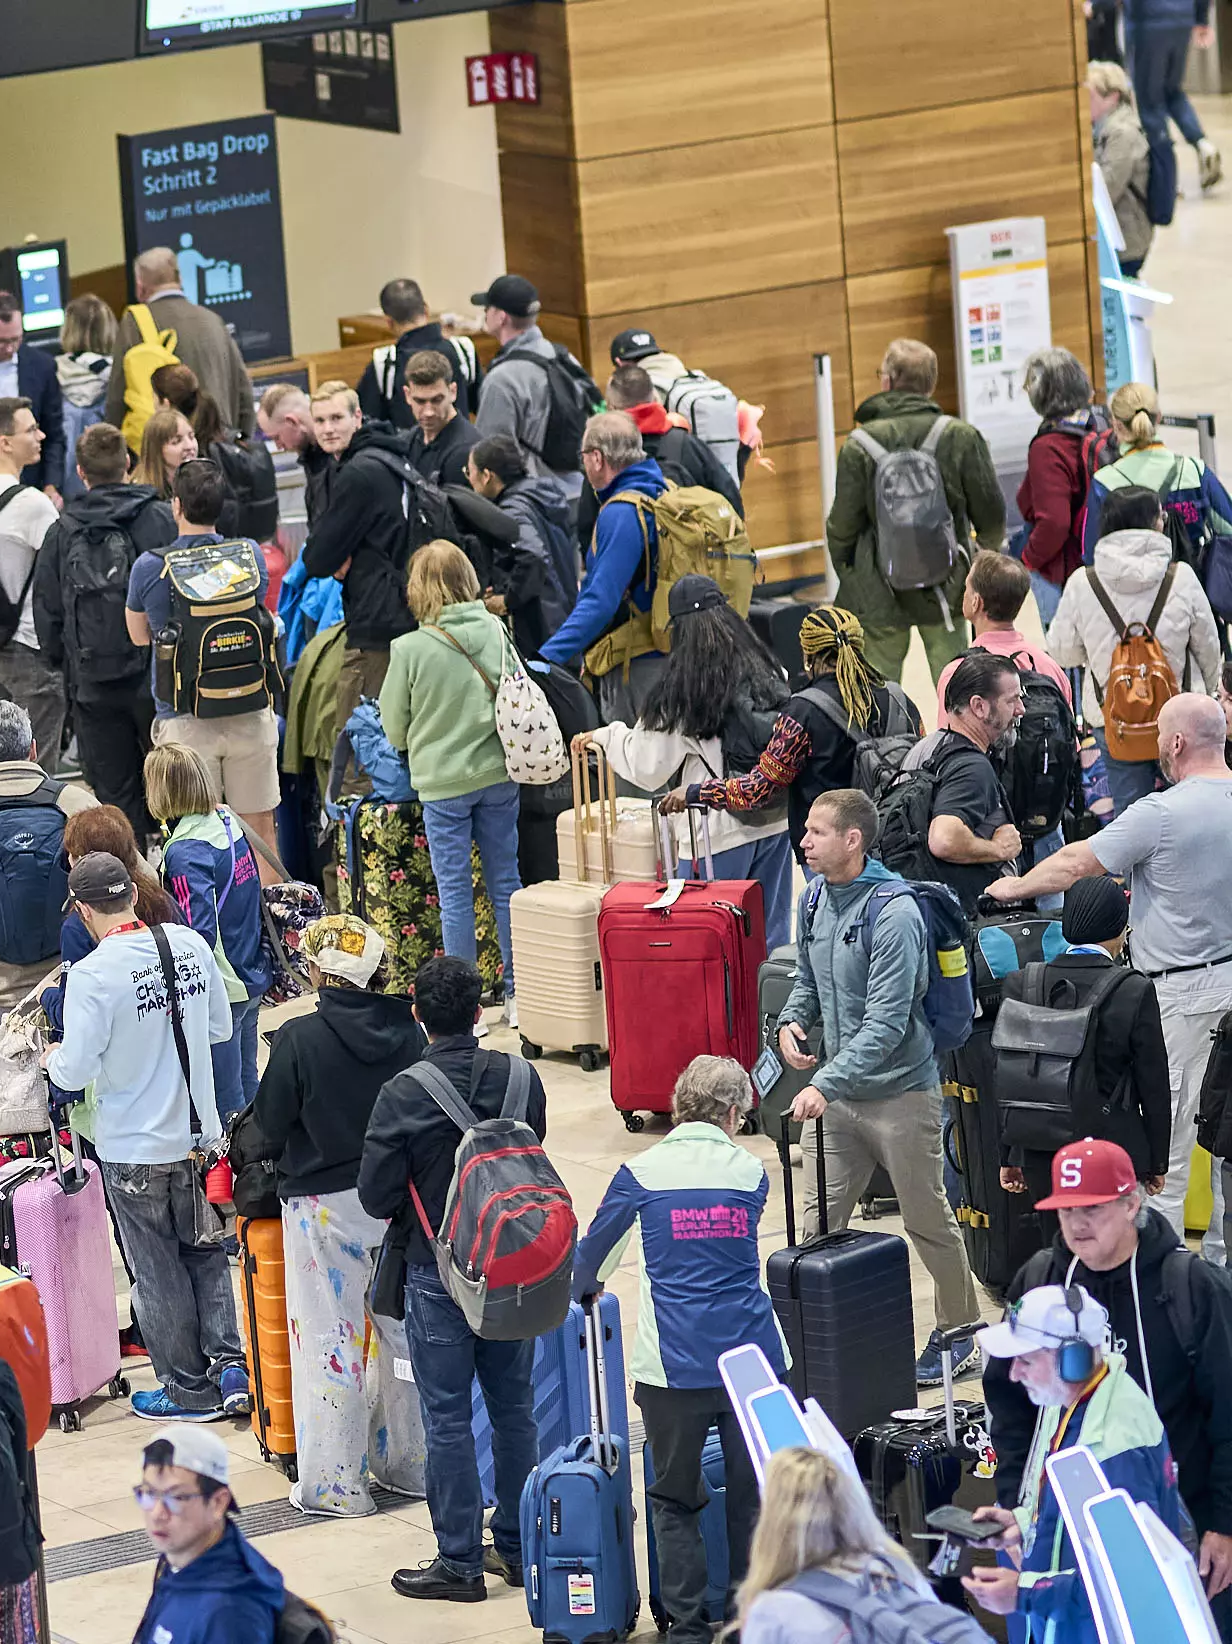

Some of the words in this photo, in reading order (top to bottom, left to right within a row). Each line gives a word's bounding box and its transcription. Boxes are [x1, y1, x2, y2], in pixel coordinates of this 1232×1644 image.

[200, 19, 231, 33] STAR
[232, 11, 289, 28] ALLIANCE
[141, 144, 178, 168] Fast
[182, 140, 219, 162] Bag
[223, 132, 269, 155] Drop
[143, 169, 201, 195] Schritt
[206, 166, 217, 185] 2
[145, 207, 168, 223] Nur
[171, 201, 192, 217] mit
[130, 964, 153, 983] Bank
[1060, 1158, 1082, 1188] S
[671, 1207, 708, 1222] BMW
[731, 1207, 748, 1223] 20
[672, 1220, 710, 1231] BERLIN
[732, 1222, 749, 1238] 25
[673, 1230, 731, 1240] MARATHON
